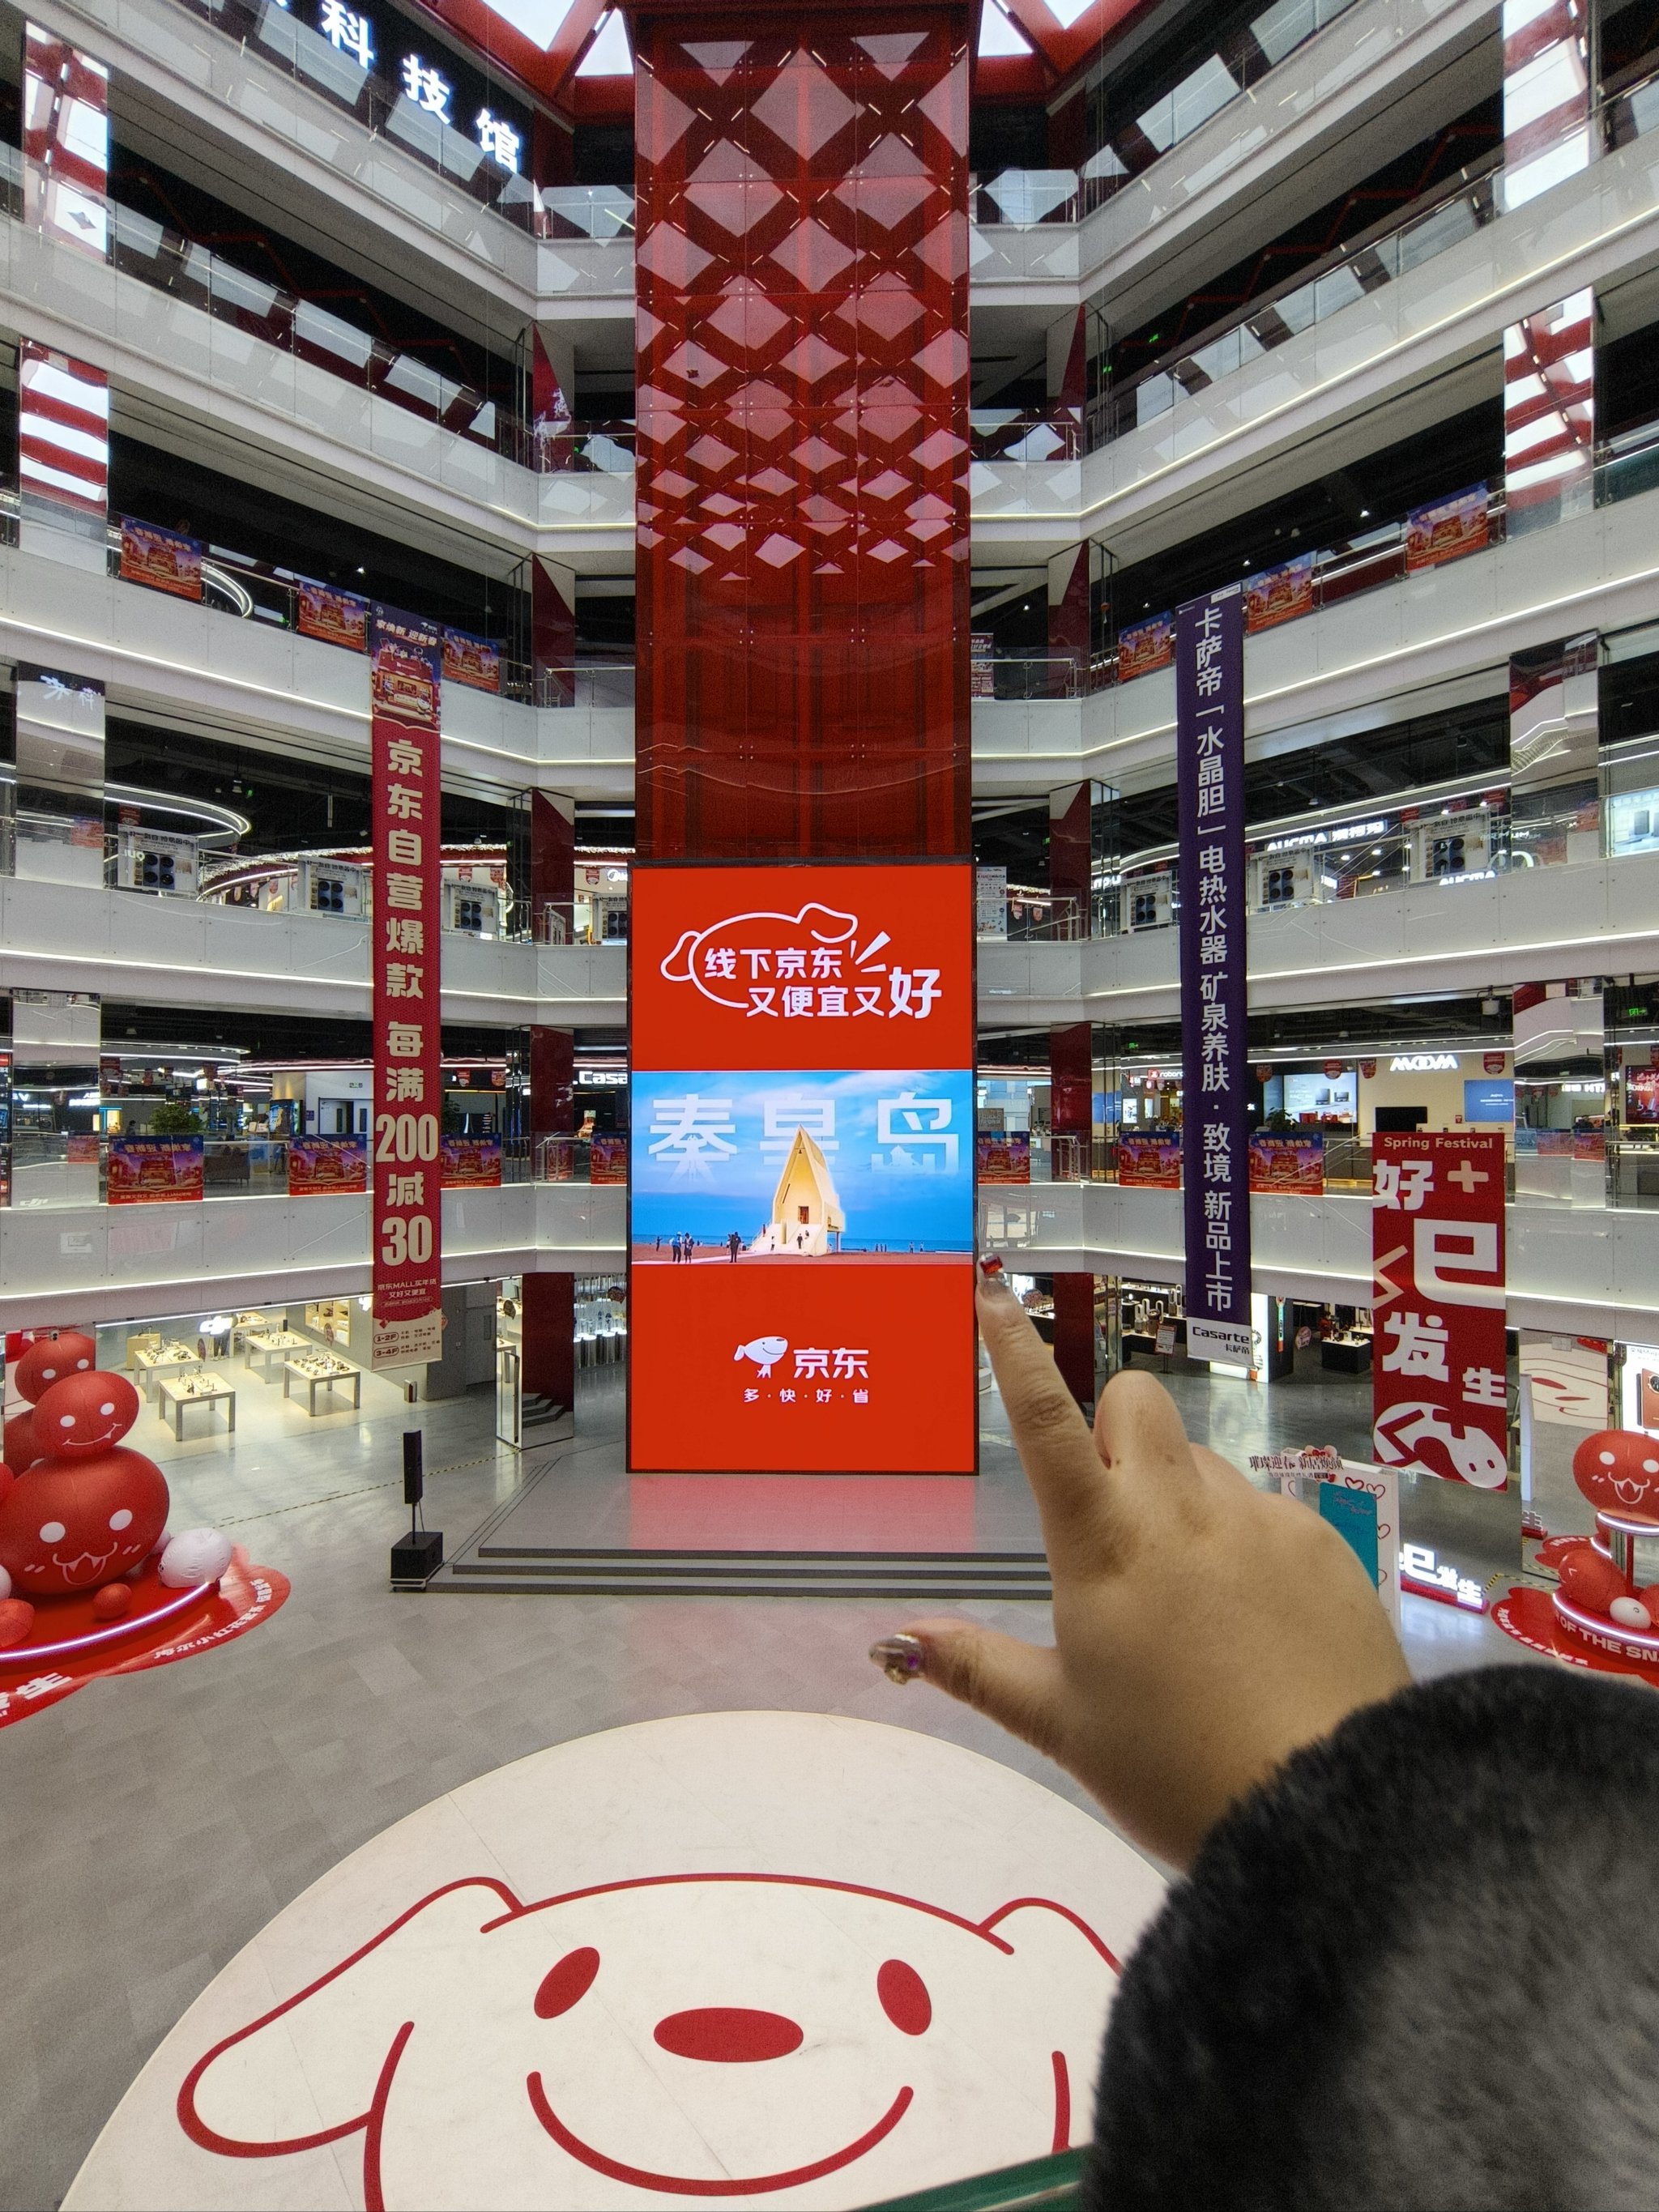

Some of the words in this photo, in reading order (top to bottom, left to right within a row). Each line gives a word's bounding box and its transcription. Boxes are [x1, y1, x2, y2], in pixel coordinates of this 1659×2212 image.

[278, 0, 520, 174] 科技馆
[386, 739, 424, 999] 京东自营爆款
[704, 947, 842, 979] 线下京东
[746, 966, 942, 1019] 又便宜又好
[648, 1091, 961, 1182] 秦皇岛
[1384, 1136, 1431, 1149] Spring
[1435, 1137, 1493, 1149] Festival
[1373, 1160, 1434, 1211] 好
[1204, 1190, 1234, 1311] 新品上市
[376, 1348, 398, 1357] 3-4F
[377, 1334, 397, 1342] 1-2F
[1192, 1326, 1250, 1345] Casarte
[1382, 1311, 1449, 1383] 发
[793, 1348, 869, 1379] 京东
[1462, 1367, 1508, 1409] 生
[1578, 1627, 1621, 1654] THE
